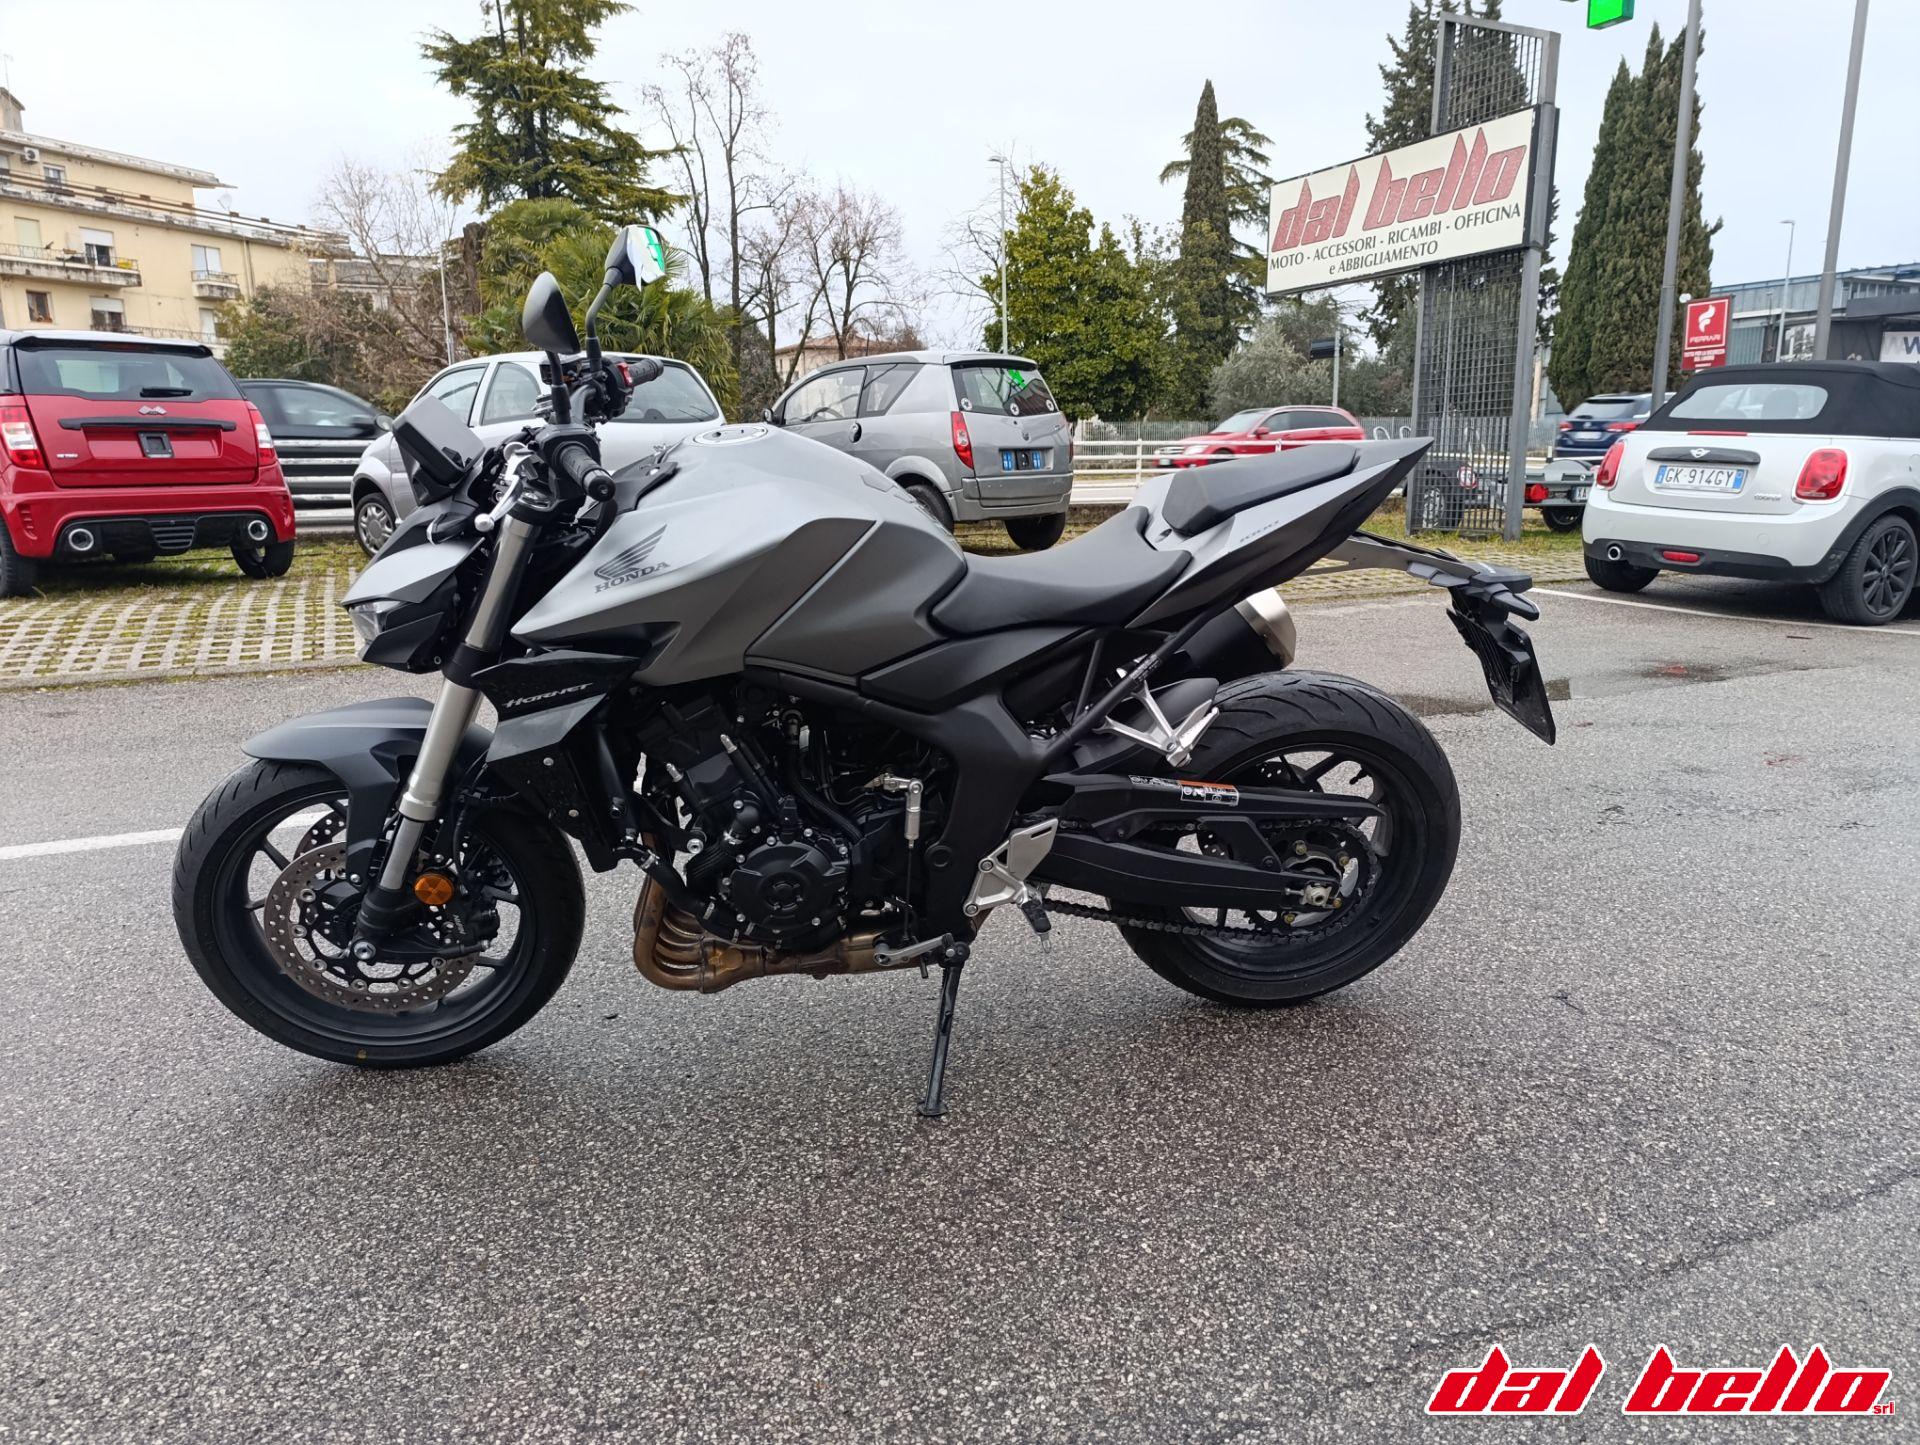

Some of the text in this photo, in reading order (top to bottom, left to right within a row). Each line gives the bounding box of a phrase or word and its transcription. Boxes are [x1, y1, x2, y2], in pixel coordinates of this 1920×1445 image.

[1271, 127, 1527, 253] dal bello
[1269, 252, 1304, 271] MOTO
[1313, 236, 1377, 262] ACCESSORI
[1388, 221, 1442, 245] RICAMBI
[1454, 202, 1521, 231] OFFICINA
[1329, 240, 1439, 275] e ABBIGLIAMENTO
[1665, 468, 1735, 487] GK 914GY
[594, 561, 671, 594] HONDA
